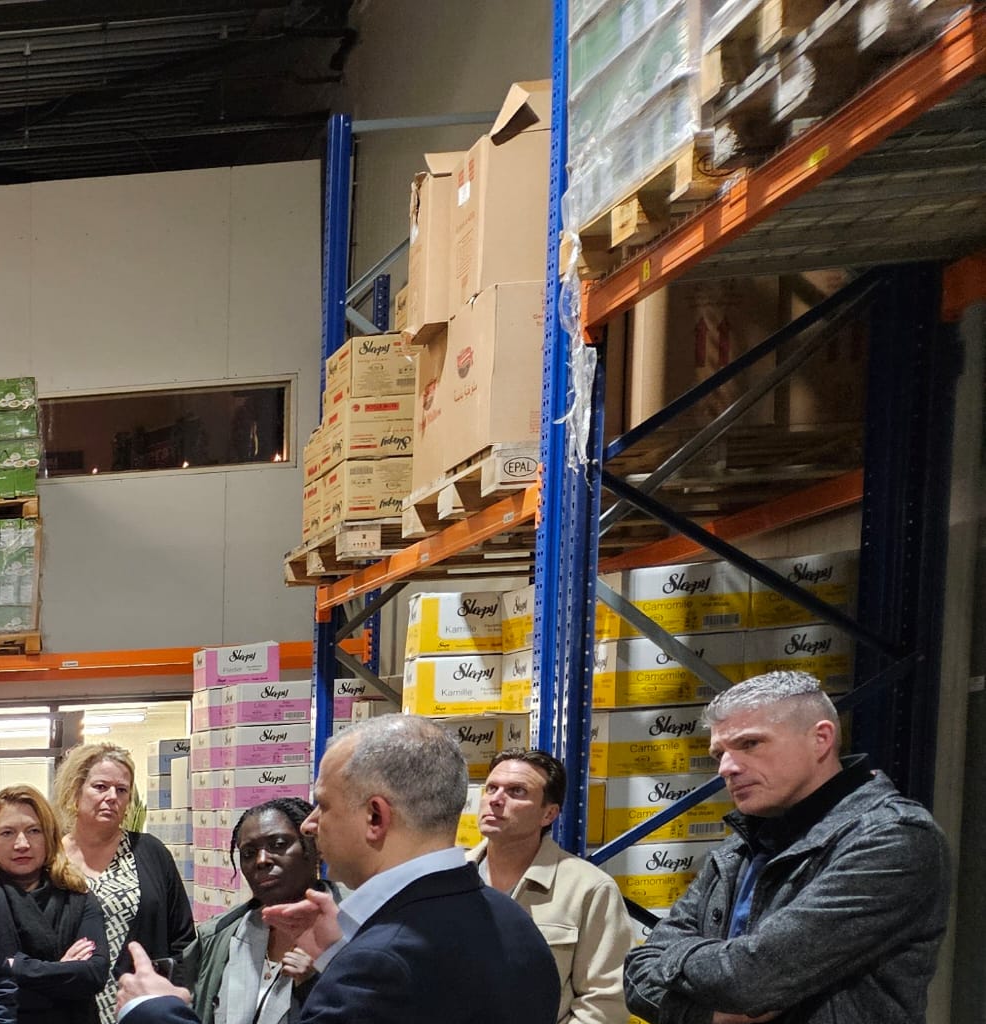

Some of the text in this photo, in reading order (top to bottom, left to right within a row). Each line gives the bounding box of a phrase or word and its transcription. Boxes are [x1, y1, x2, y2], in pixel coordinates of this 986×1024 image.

[359, 341, 391, 356] Sleepy
[508, 462, 533, 473] EPAL
[788, 562, 833, 584] Sleepy
[662, 572, 711, 595] Sleepy
[457, 598, 498, 619] Sleepy
[642, 601, 693, 612] Camomile
[445, 624, 477, 633] Kamille
[784, 632, 832, 656] Sleepy
[229, 649, 256, 662] Sleepy
[453, 662, 495, 683] Sleepy
[637, 670, 687, 682] Camomile
[261, 685, 289, 699] Sleepy
[338, 682, 366, 696] Sleepy
[441, 689, 473, 697] Kamille
[649, 716, 698, 737] Sleepy
[259, 729, 287, 742] Sleepy
[455, 726, 495, 746] Sleepy
[630, 742, 679, 754] Camomile
[258, 771, 286, 784] Sleepy
[646, 851, 694, 872] Sleepy
[626, 877, 676, 887] Camomile
